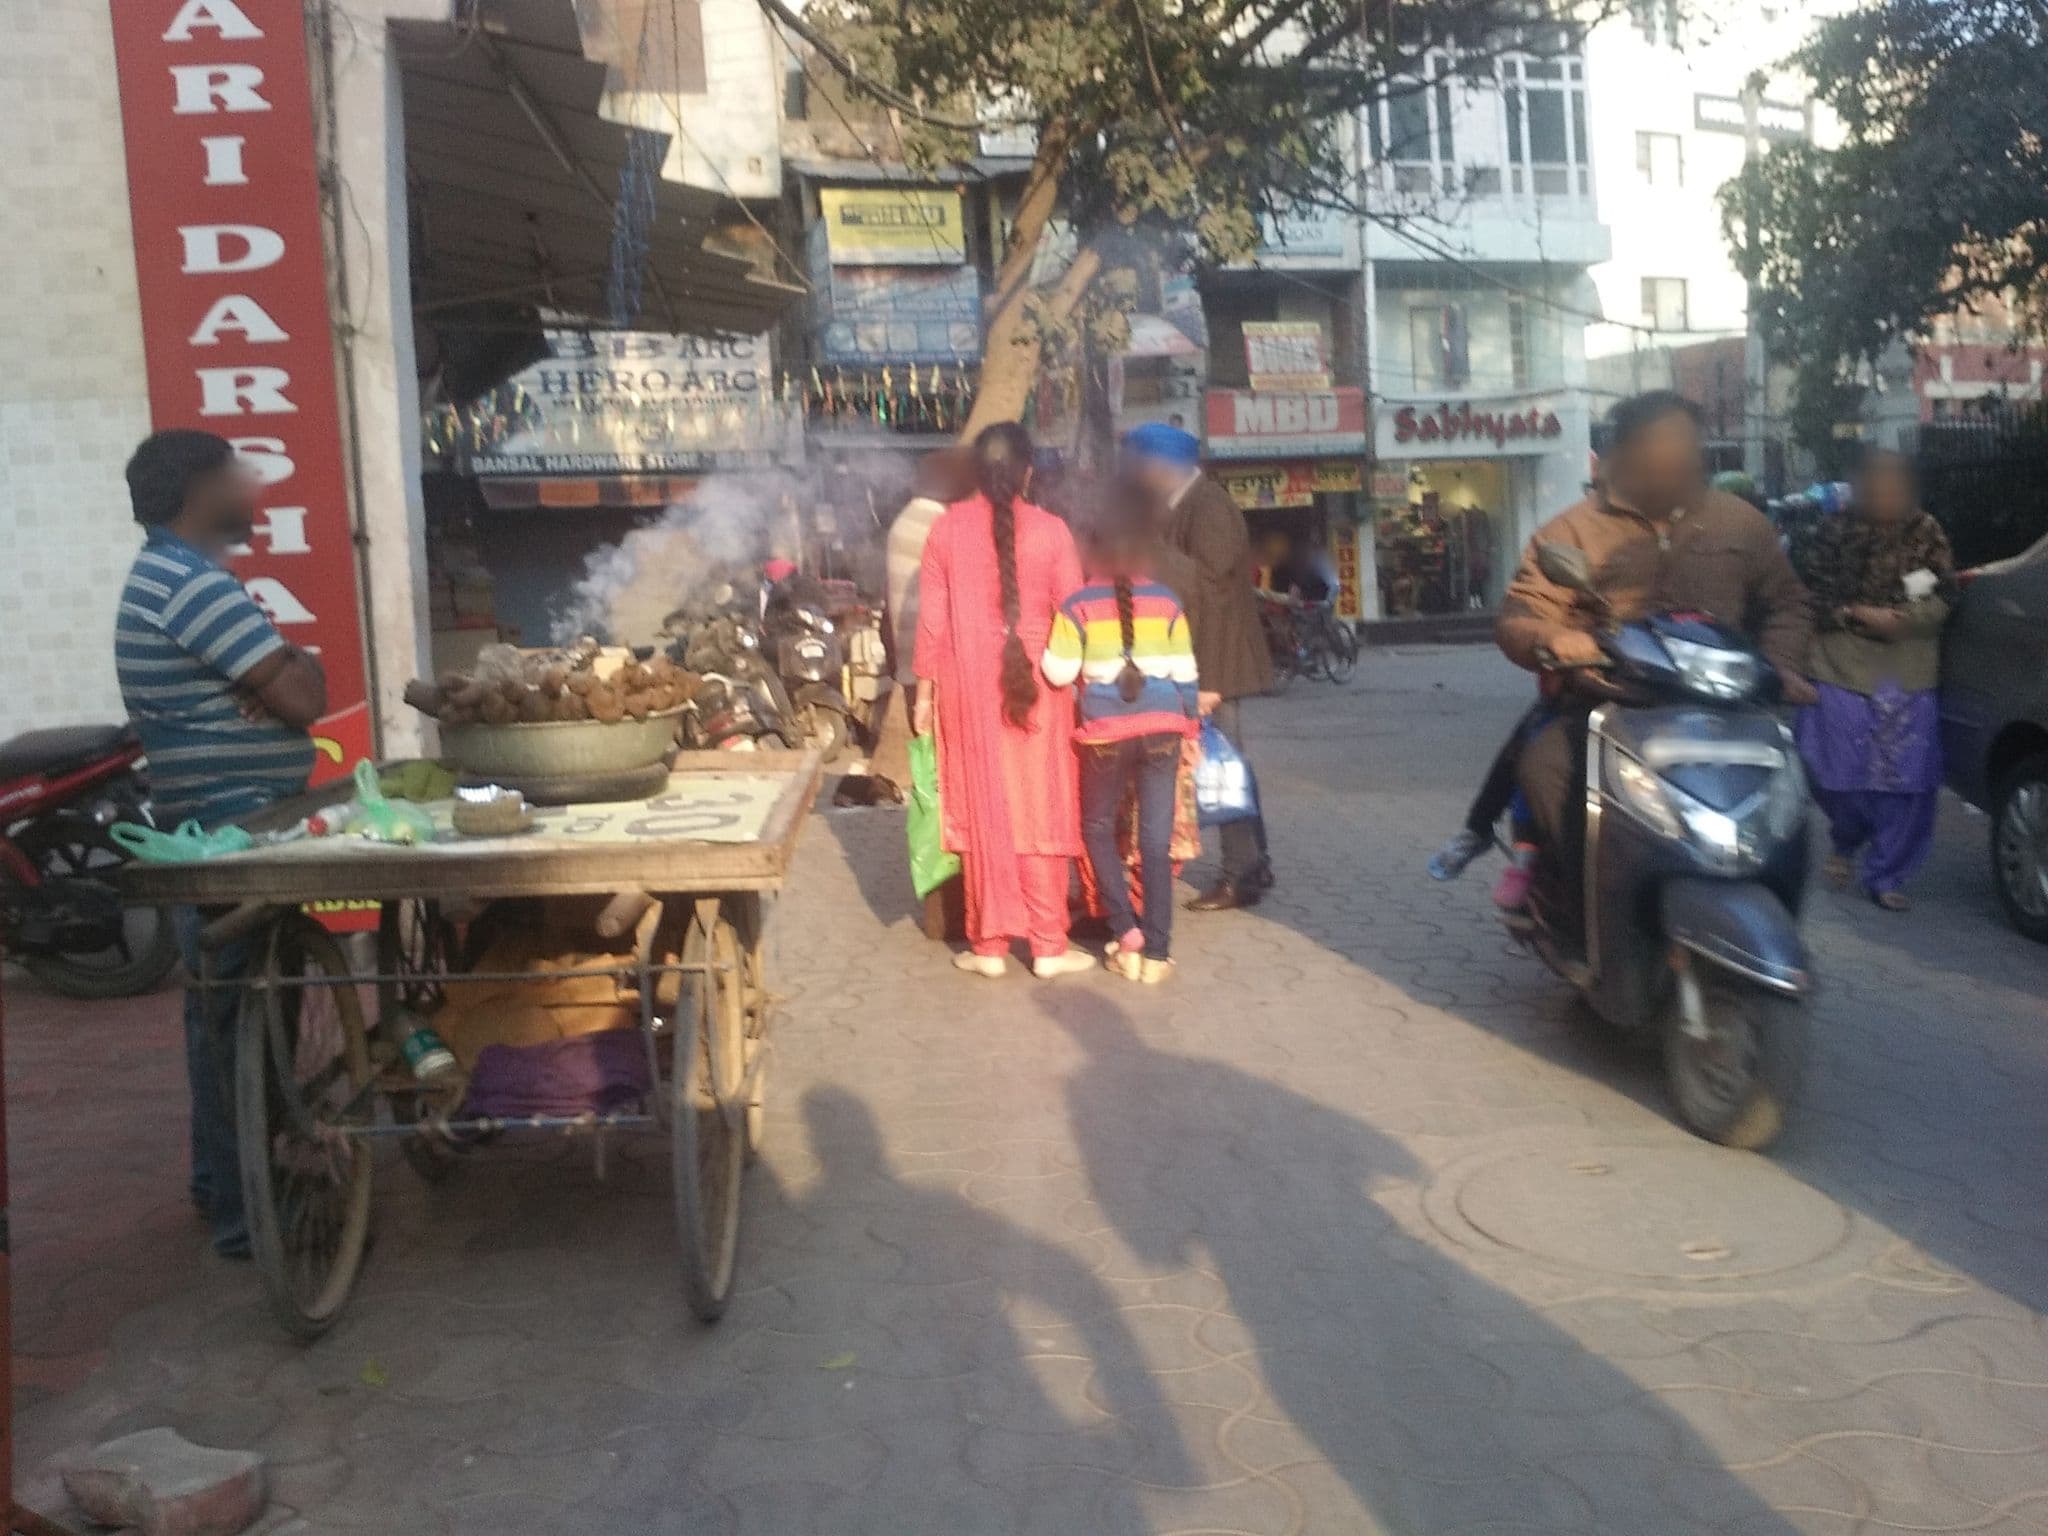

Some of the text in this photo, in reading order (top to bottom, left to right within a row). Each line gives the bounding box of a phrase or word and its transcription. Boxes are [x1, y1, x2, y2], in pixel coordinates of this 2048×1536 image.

[540, 368, 759, 394] HERO ARC
[1394, 401, 1562, 449] Sabhyata
